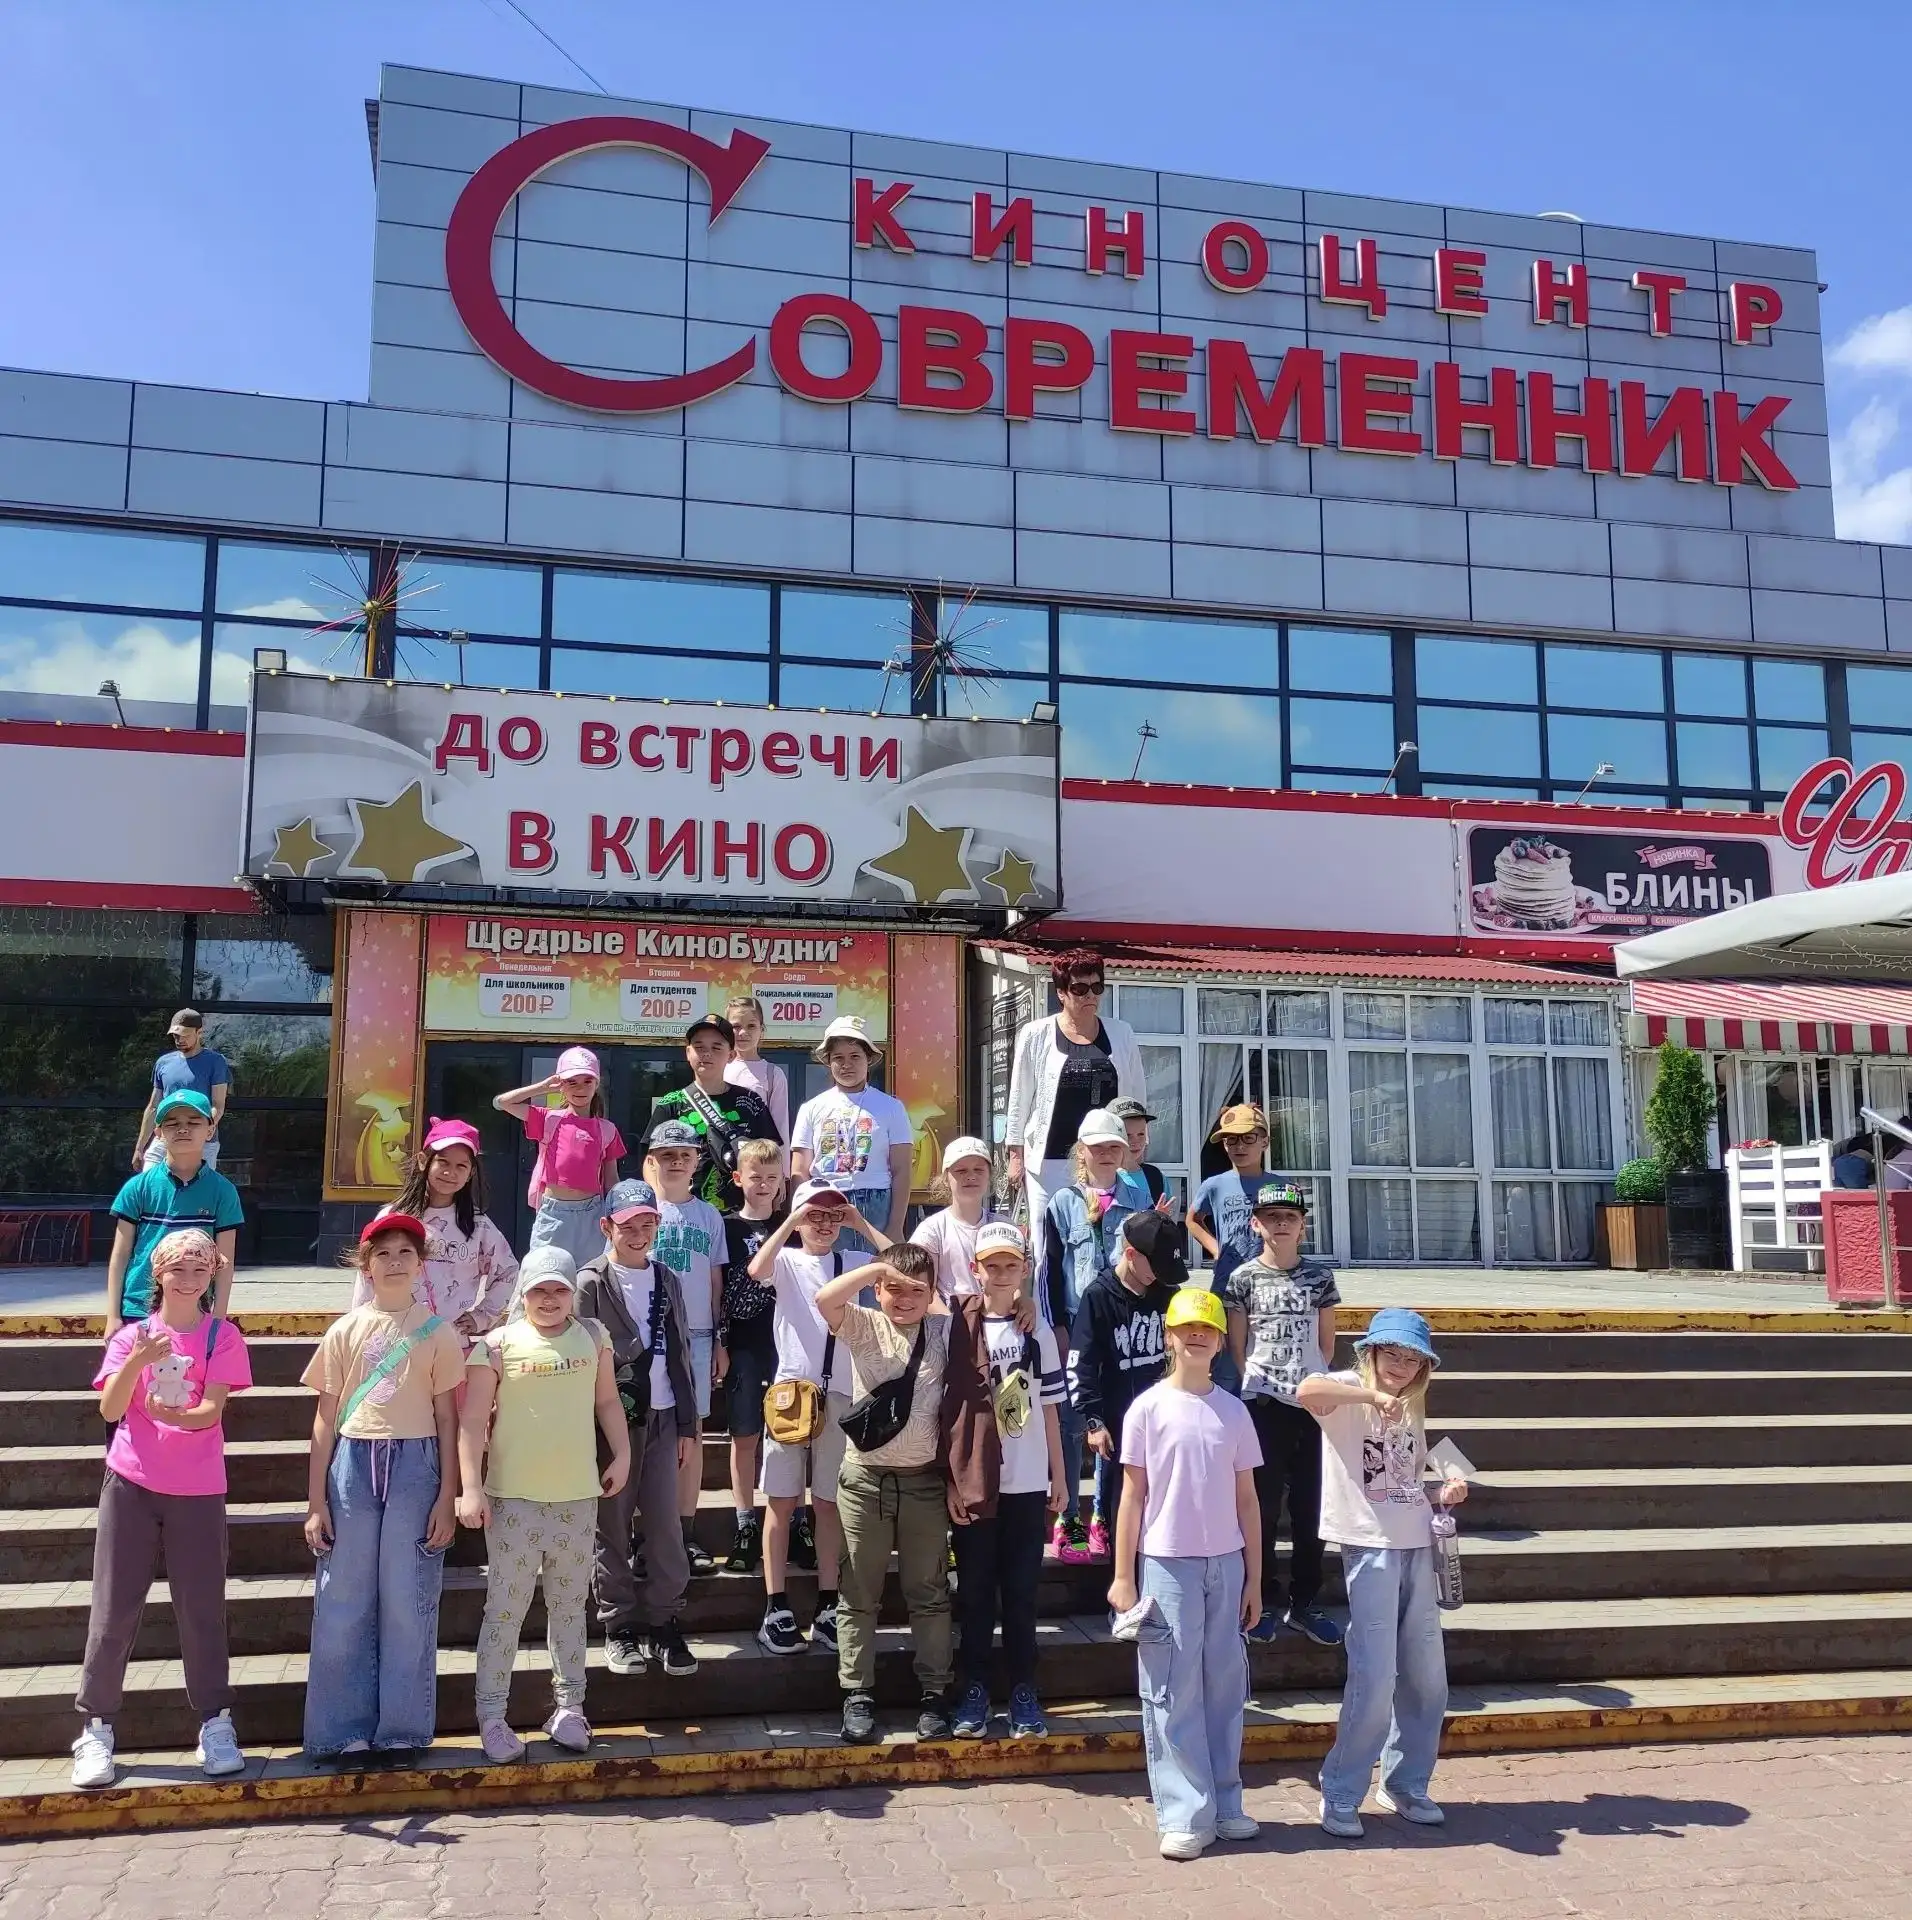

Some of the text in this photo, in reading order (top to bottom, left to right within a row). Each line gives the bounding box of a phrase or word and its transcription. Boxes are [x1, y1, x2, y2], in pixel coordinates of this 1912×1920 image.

[853, 177, 1784, 347] КИНОЦЕНТР
[580, 719, 904, 792] встречи
[1653, 848, 1700, 865] НОВИНКА
[1605, 871, 1755, 910] БЛИНЫ
[1591, 914, 1644, 924] КЛАССИЧЕСКИЕ
[466, 920, 625, 956] Щедрые
[499, 961, 552, 973] Понедельник
[648, 968, 681, 978] Вторник
[783, 973, 806, 982] Среда
[485, 978, 565, 991] Для школьников
[630, 984, 697, 996] Для студентов
[755, 989, 834, 1000] Социальный кинозал
[618, 1187, 652, 1201] BOSTON
